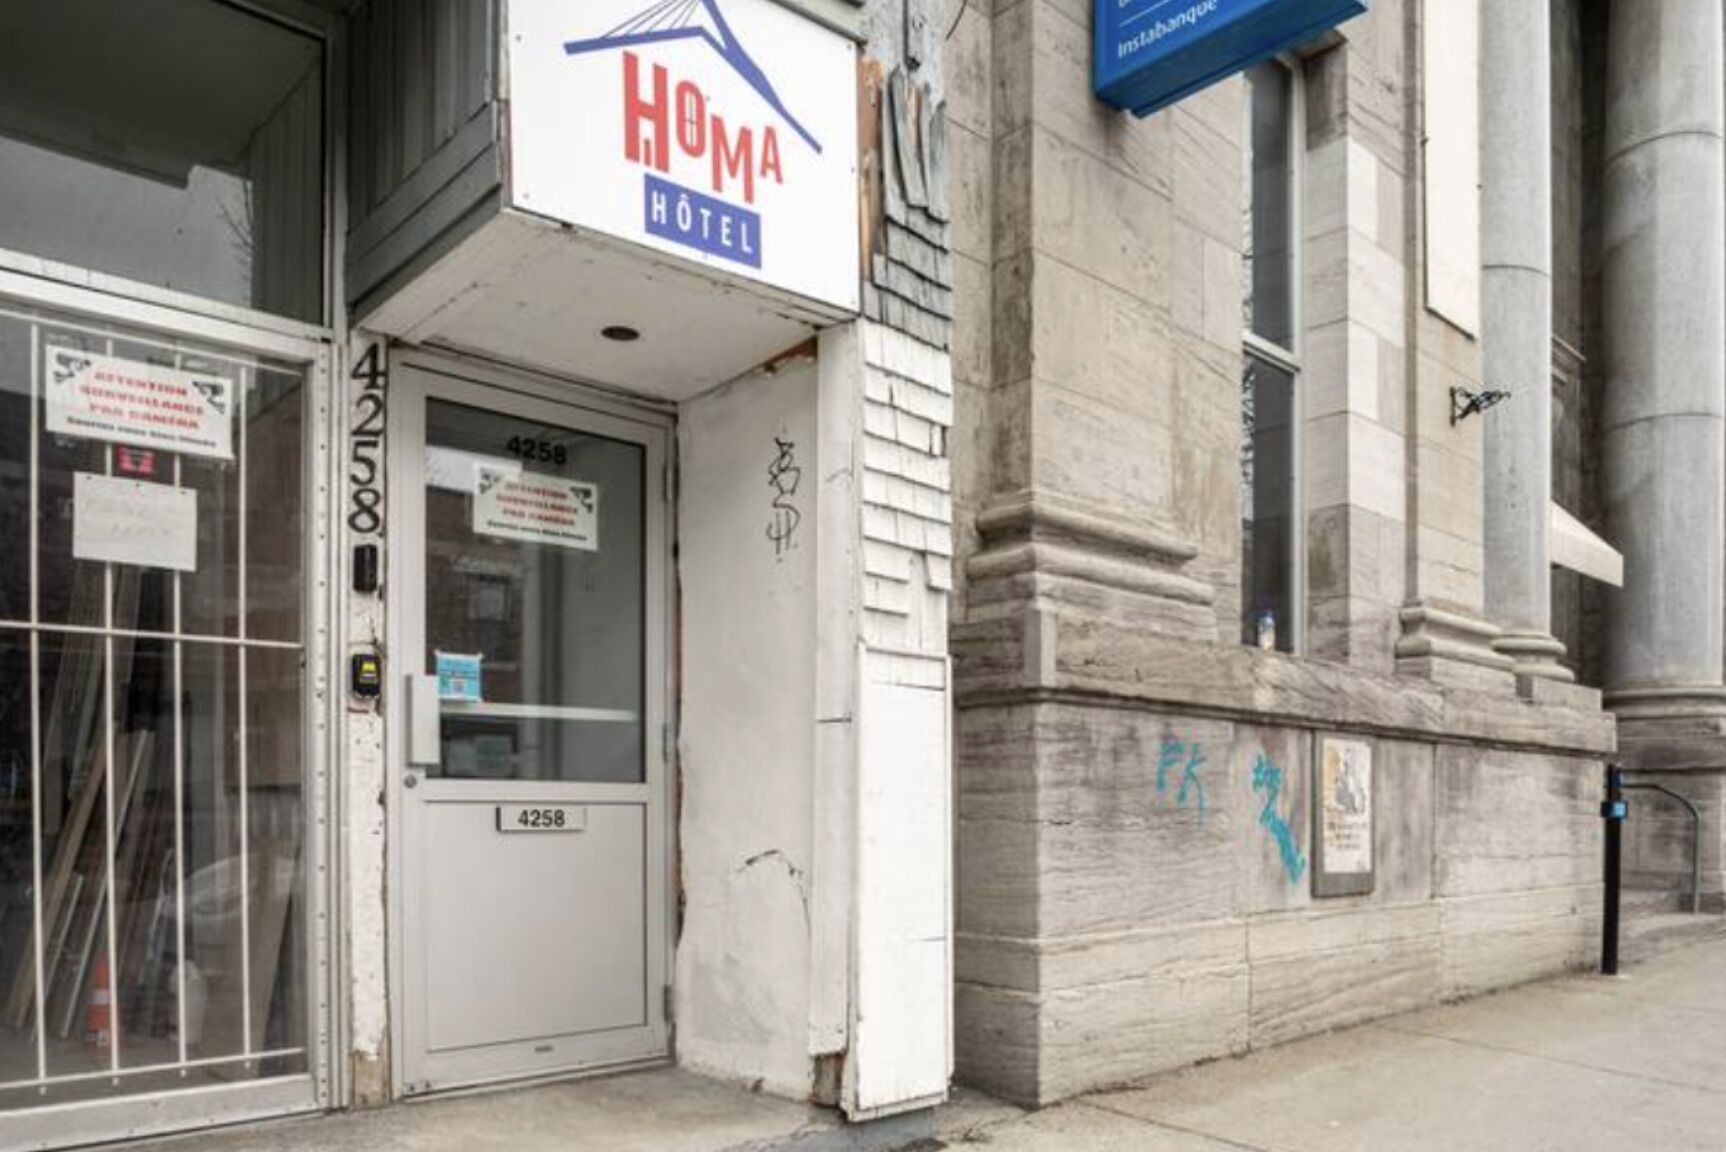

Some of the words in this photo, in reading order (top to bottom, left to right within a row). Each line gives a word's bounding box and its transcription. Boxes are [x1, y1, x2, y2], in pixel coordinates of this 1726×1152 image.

[1118, 0, 1218, 58] Instabanque
[623, 50, 784, 205] HOMA
[651, 189, 754, 255] HÔTEL
[347, 342, 387, 533] 4258
[506, 436, 568, 465] 4258
[517, 809, 565, 828] 4258
